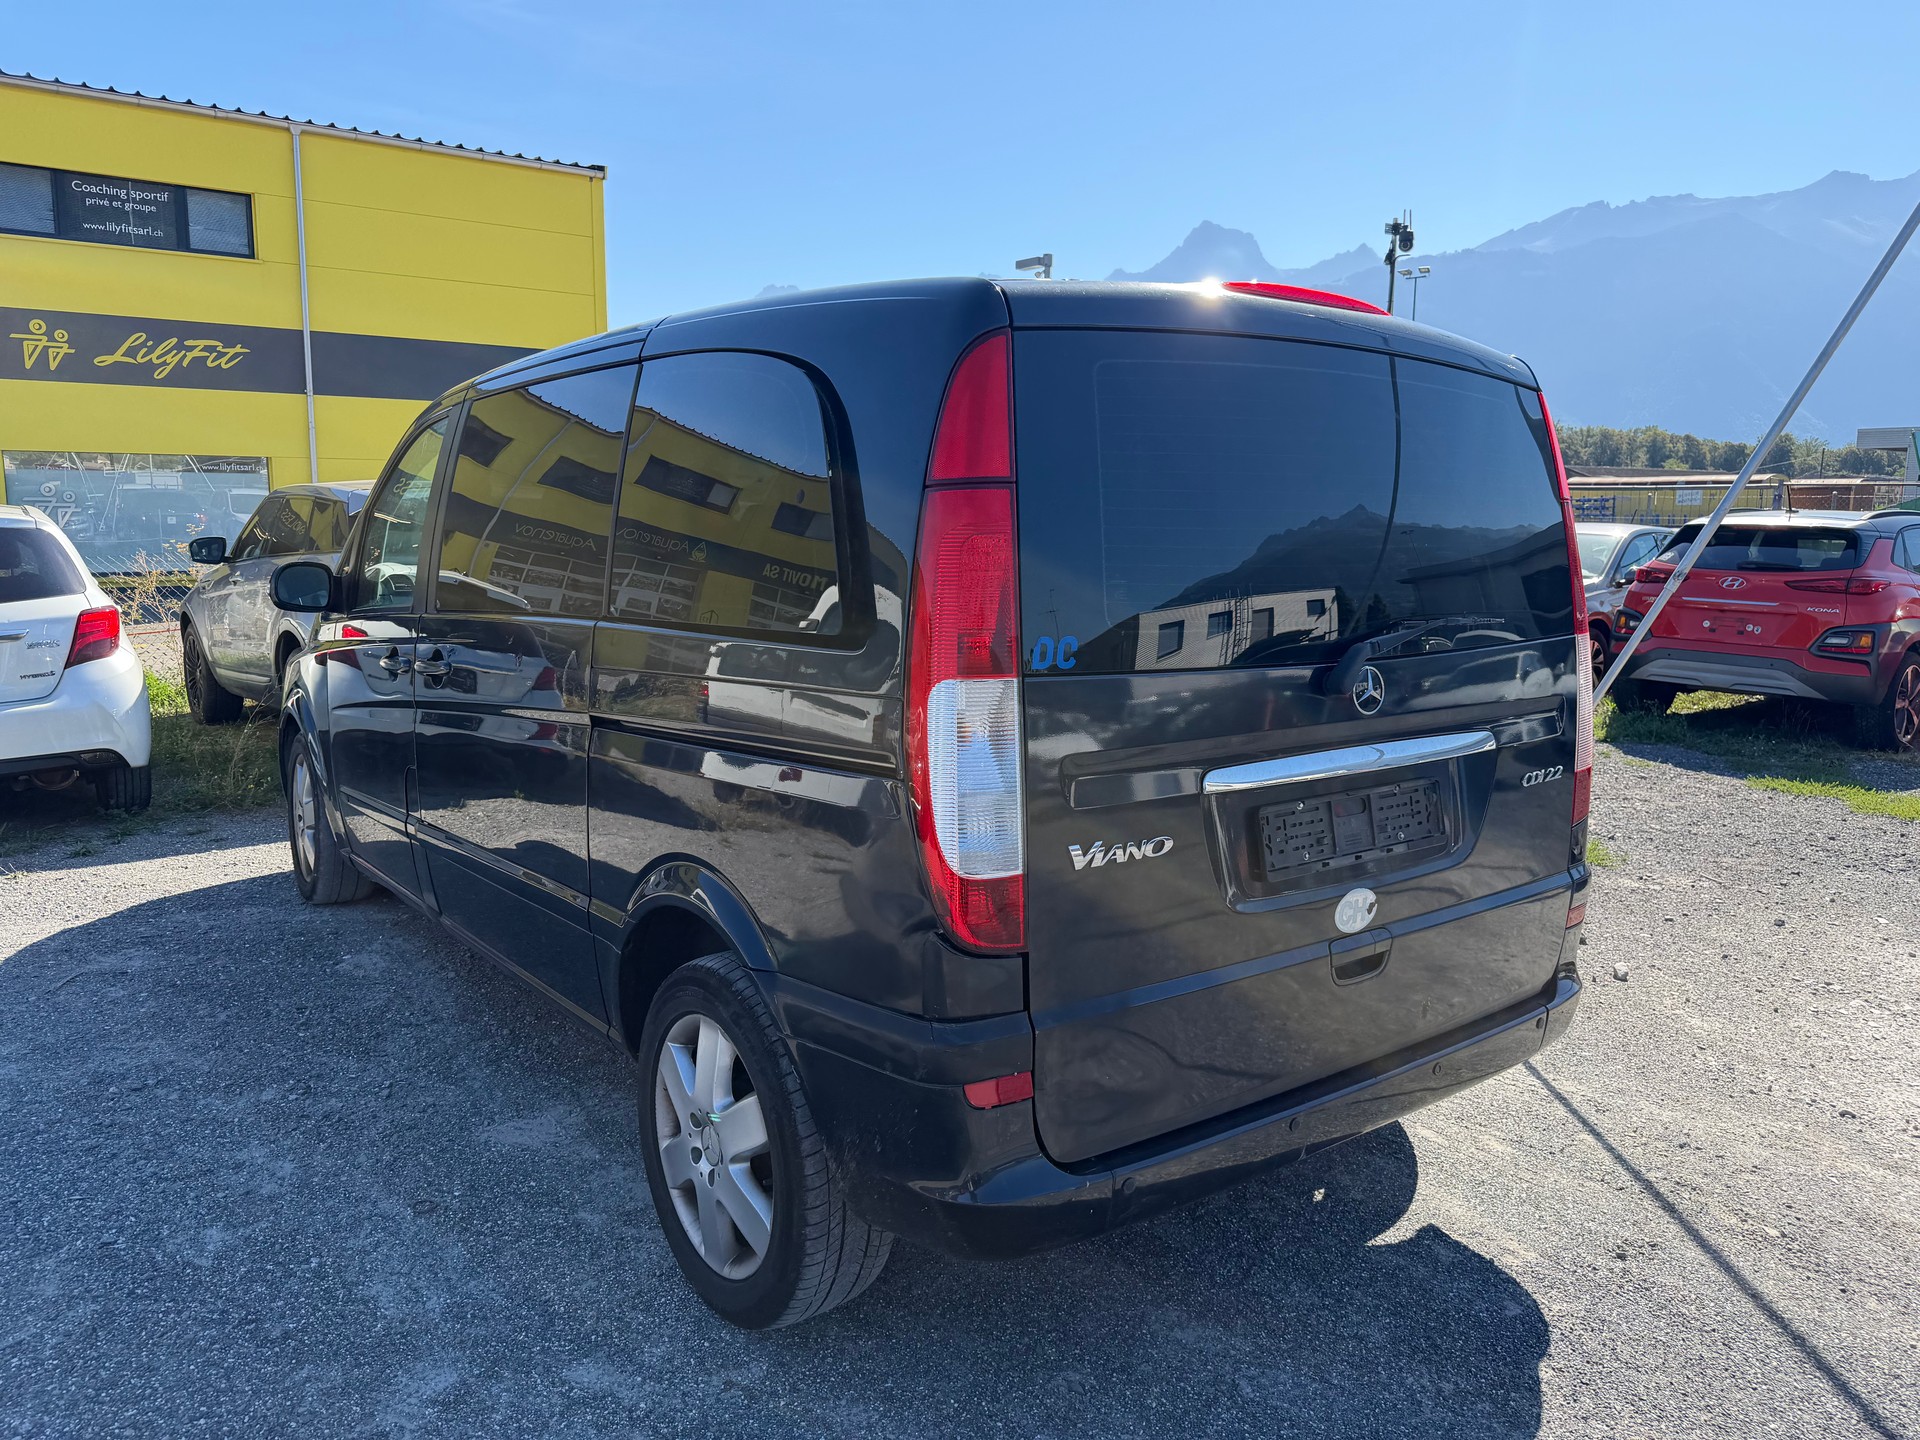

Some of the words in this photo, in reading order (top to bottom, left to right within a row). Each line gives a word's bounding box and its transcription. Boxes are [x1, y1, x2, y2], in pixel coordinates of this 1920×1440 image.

[72, 180, 127, 199] Coaching
[130, 190, 169, 202] sportif
[86, 197, 110, 206] privé
[112, 200, 122, 208] et
[125, 202, 157, 213] groupe
[83, 222, 163, 237] www.lilyfitsarl.ch
[94, 332, 251, 379] LilyFit
[1032, 635, 1078, 670] DC
[1068, 836, 1174, 870] VIANO
